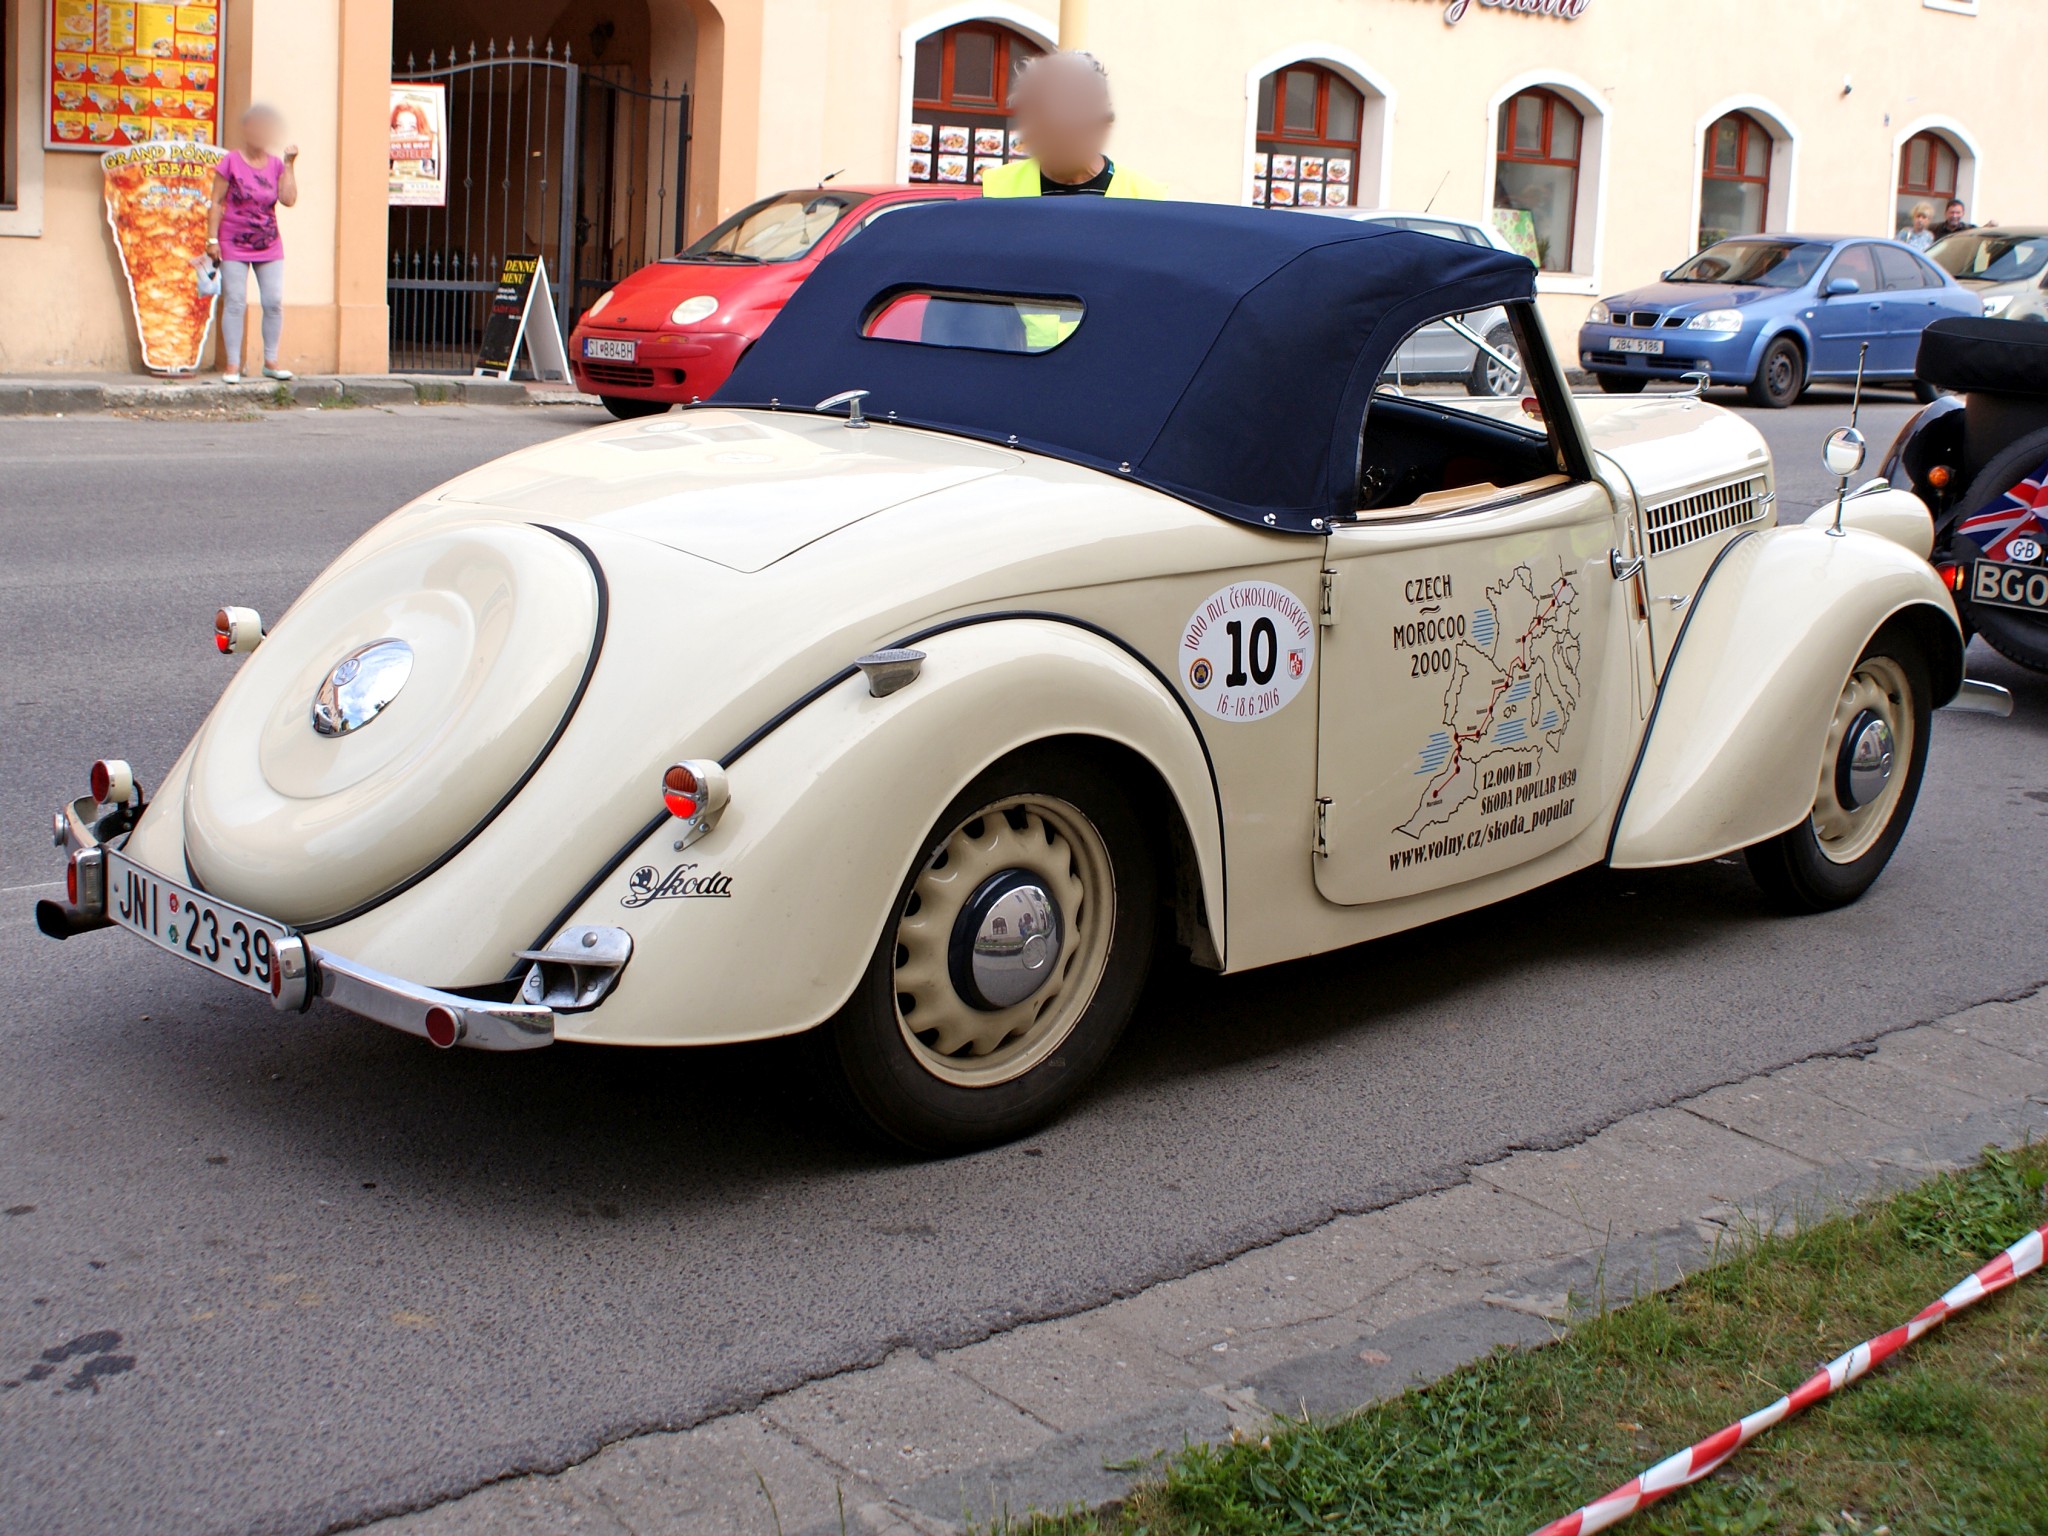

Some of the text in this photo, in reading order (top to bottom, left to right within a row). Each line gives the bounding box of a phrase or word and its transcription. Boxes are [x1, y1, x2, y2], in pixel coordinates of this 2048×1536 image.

[104, 143, 223, 169] GRAND DÖNN
[142, 162, 204, 177] KEBAB
[501, 273, 526, 285] MENU
[505, 258, 537, 273] DENNÉ
[2013, 541, 2034, 558] GB
[1405, 574, 1452, 604] CZECH
[1184, 586, 1310, 650] 1000 MIL ČESKOSLOVENSKÝCH
[1393, 614, 1465, 650] MOROCOO
[1226, 616, 1278, 688] 10
[1410, 648, 1451, 678] 2000
[1482, 761, 1532, 790] 12.000 km
[1515, 775, 1556, 805] POPULAR
[1558, 768, 1577, 791] 1939
[1389, 798, 1575, 872] www.volny.cz/skoda_popular
[119, 869, 272, 983] JNI 23-39
